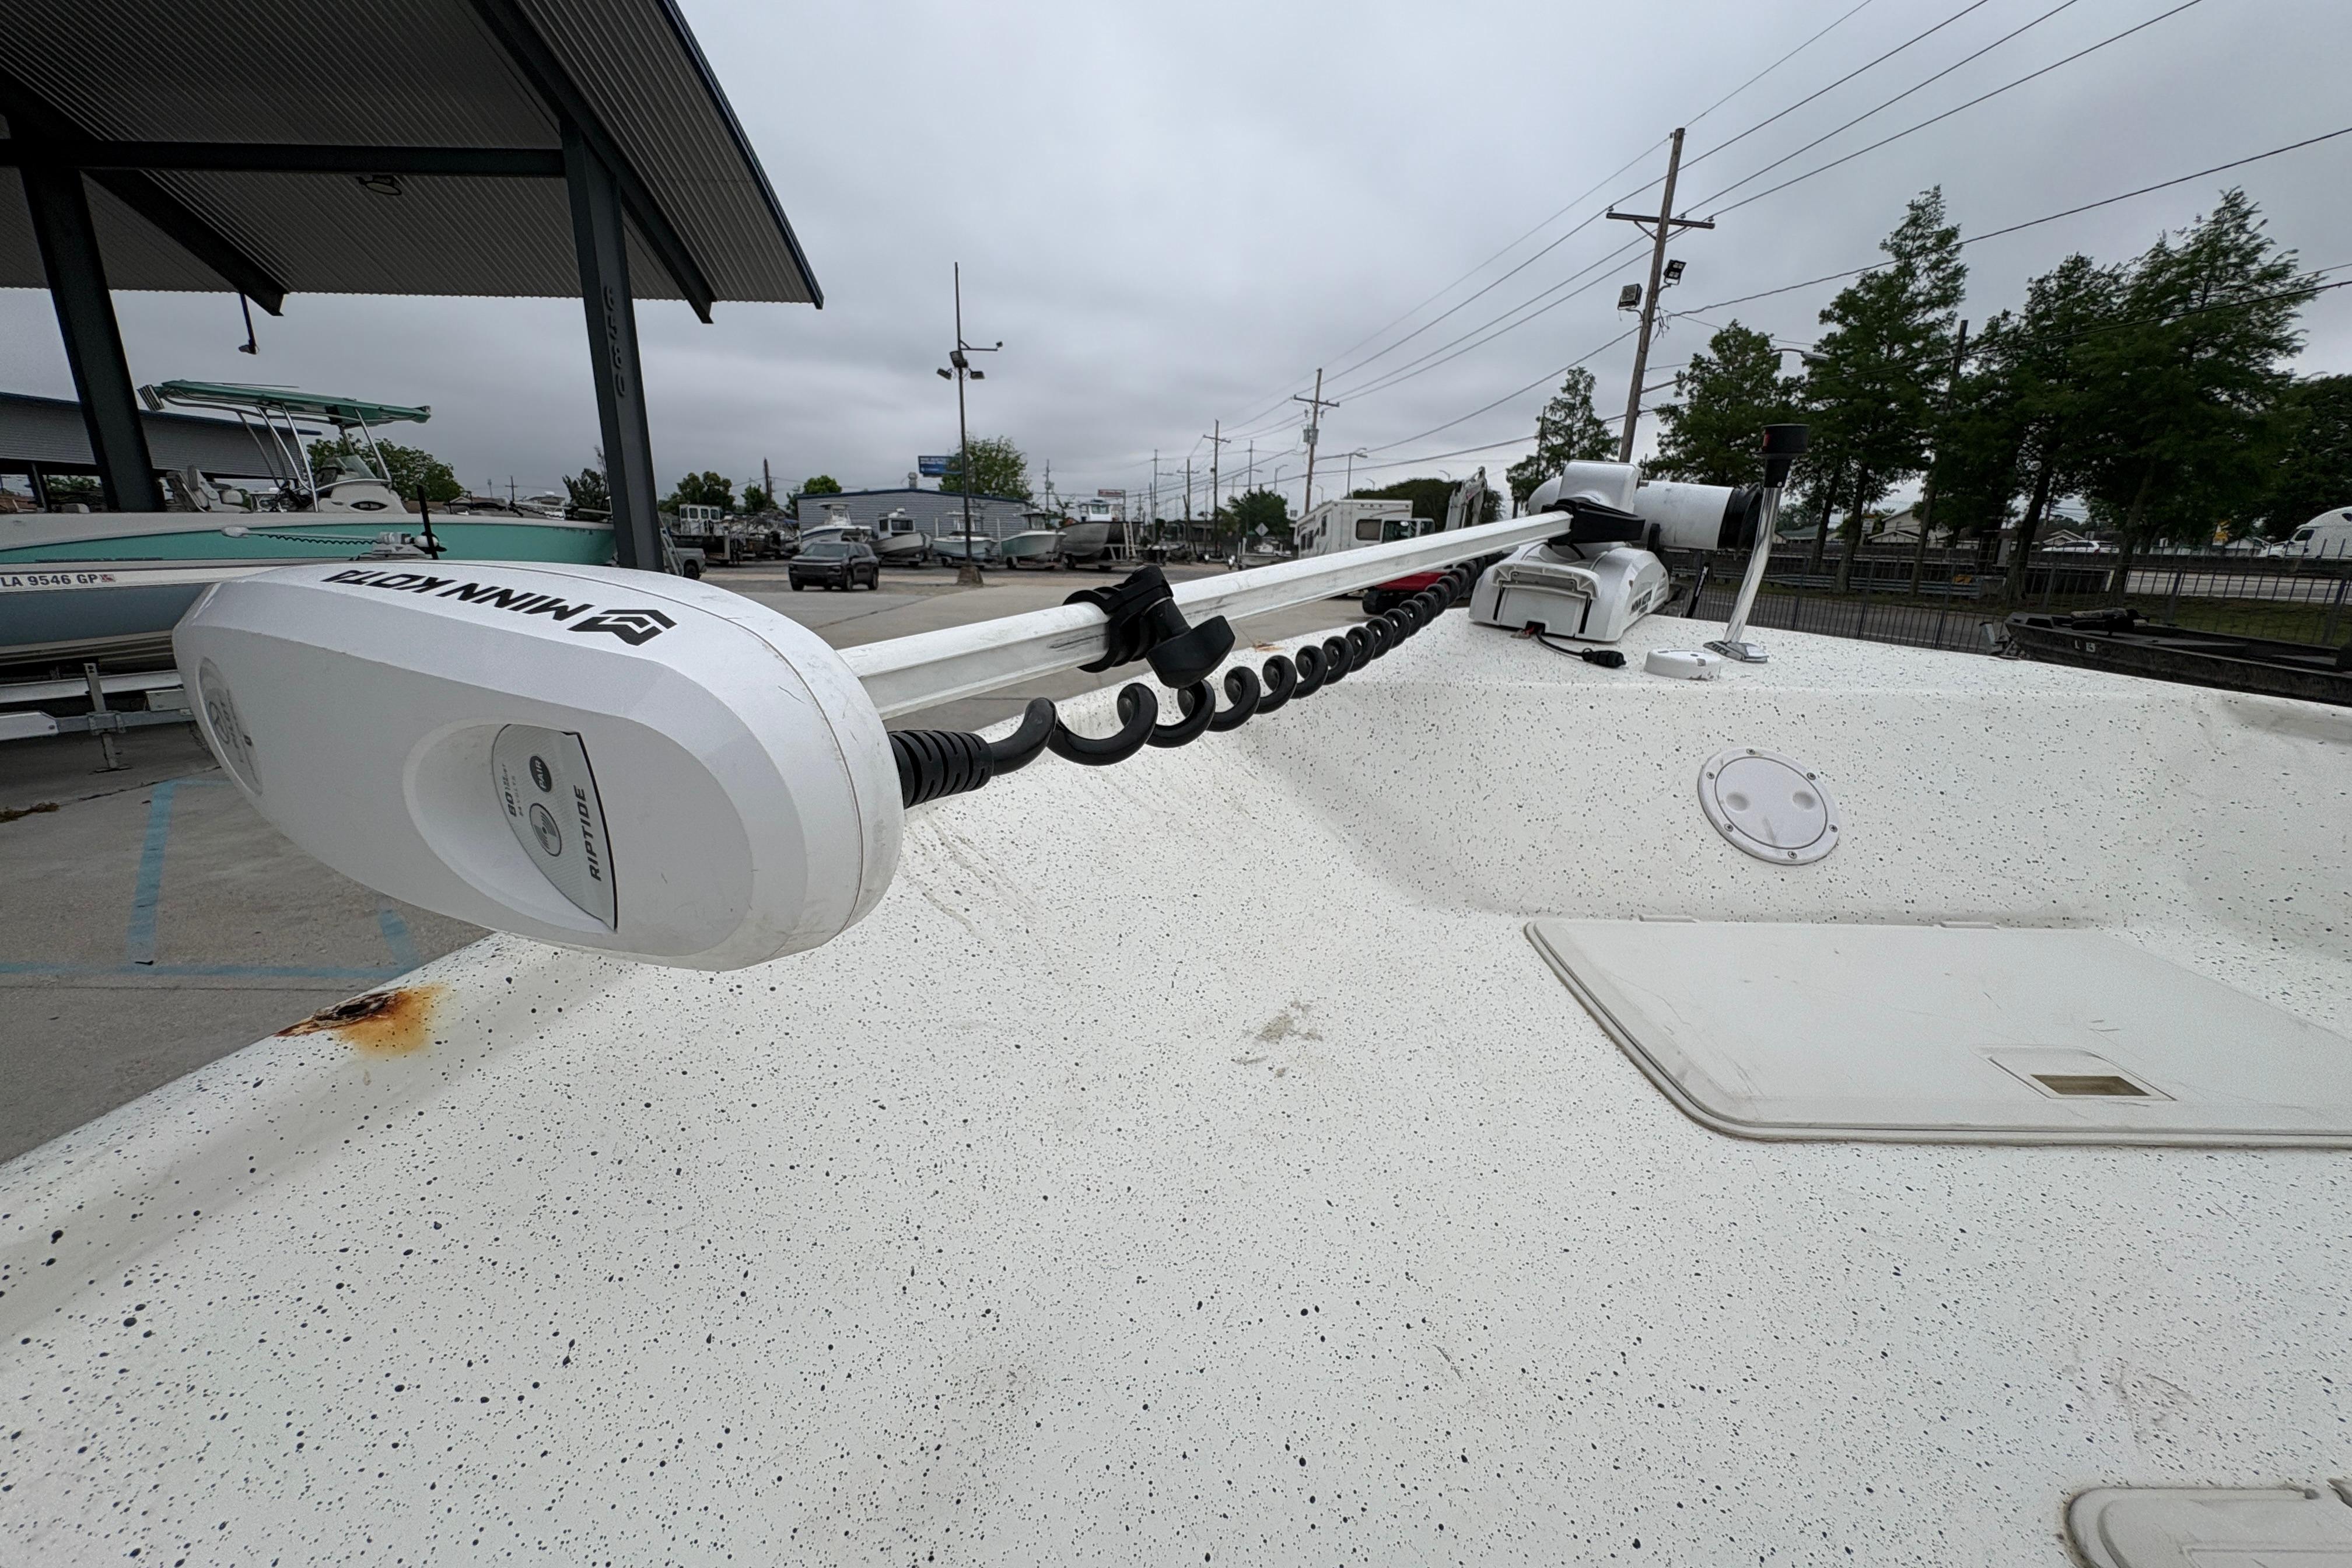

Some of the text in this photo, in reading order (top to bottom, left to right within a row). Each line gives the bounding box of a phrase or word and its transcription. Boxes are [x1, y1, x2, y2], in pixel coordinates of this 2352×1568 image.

[1, 574, 98, 587] LA 9546 GP
[320, 570, 595, 621] MINN KOTA
[534, 760, 547, 789] PAIR
[505, 791, 516, 817] 80
[573, 785, 601, 881] RIPTIDE
